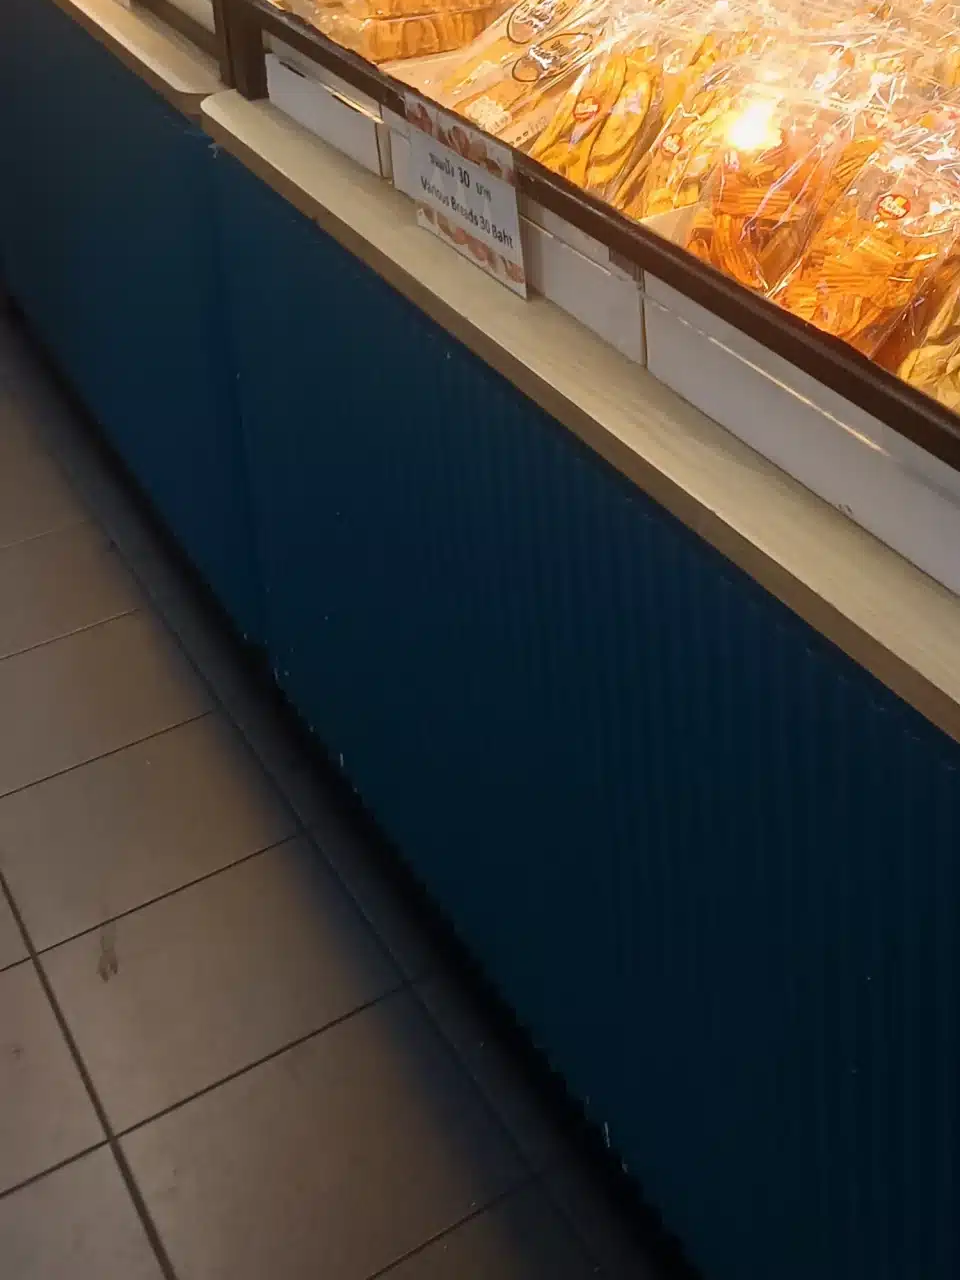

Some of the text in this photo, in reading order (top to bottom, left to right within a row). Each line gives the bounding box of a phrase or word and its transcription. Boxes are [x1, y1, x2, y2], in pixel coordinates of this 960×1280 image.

[457, 167, 470, 188] 30
[420, 176, 513, 249] Various Breads 30 Baht
